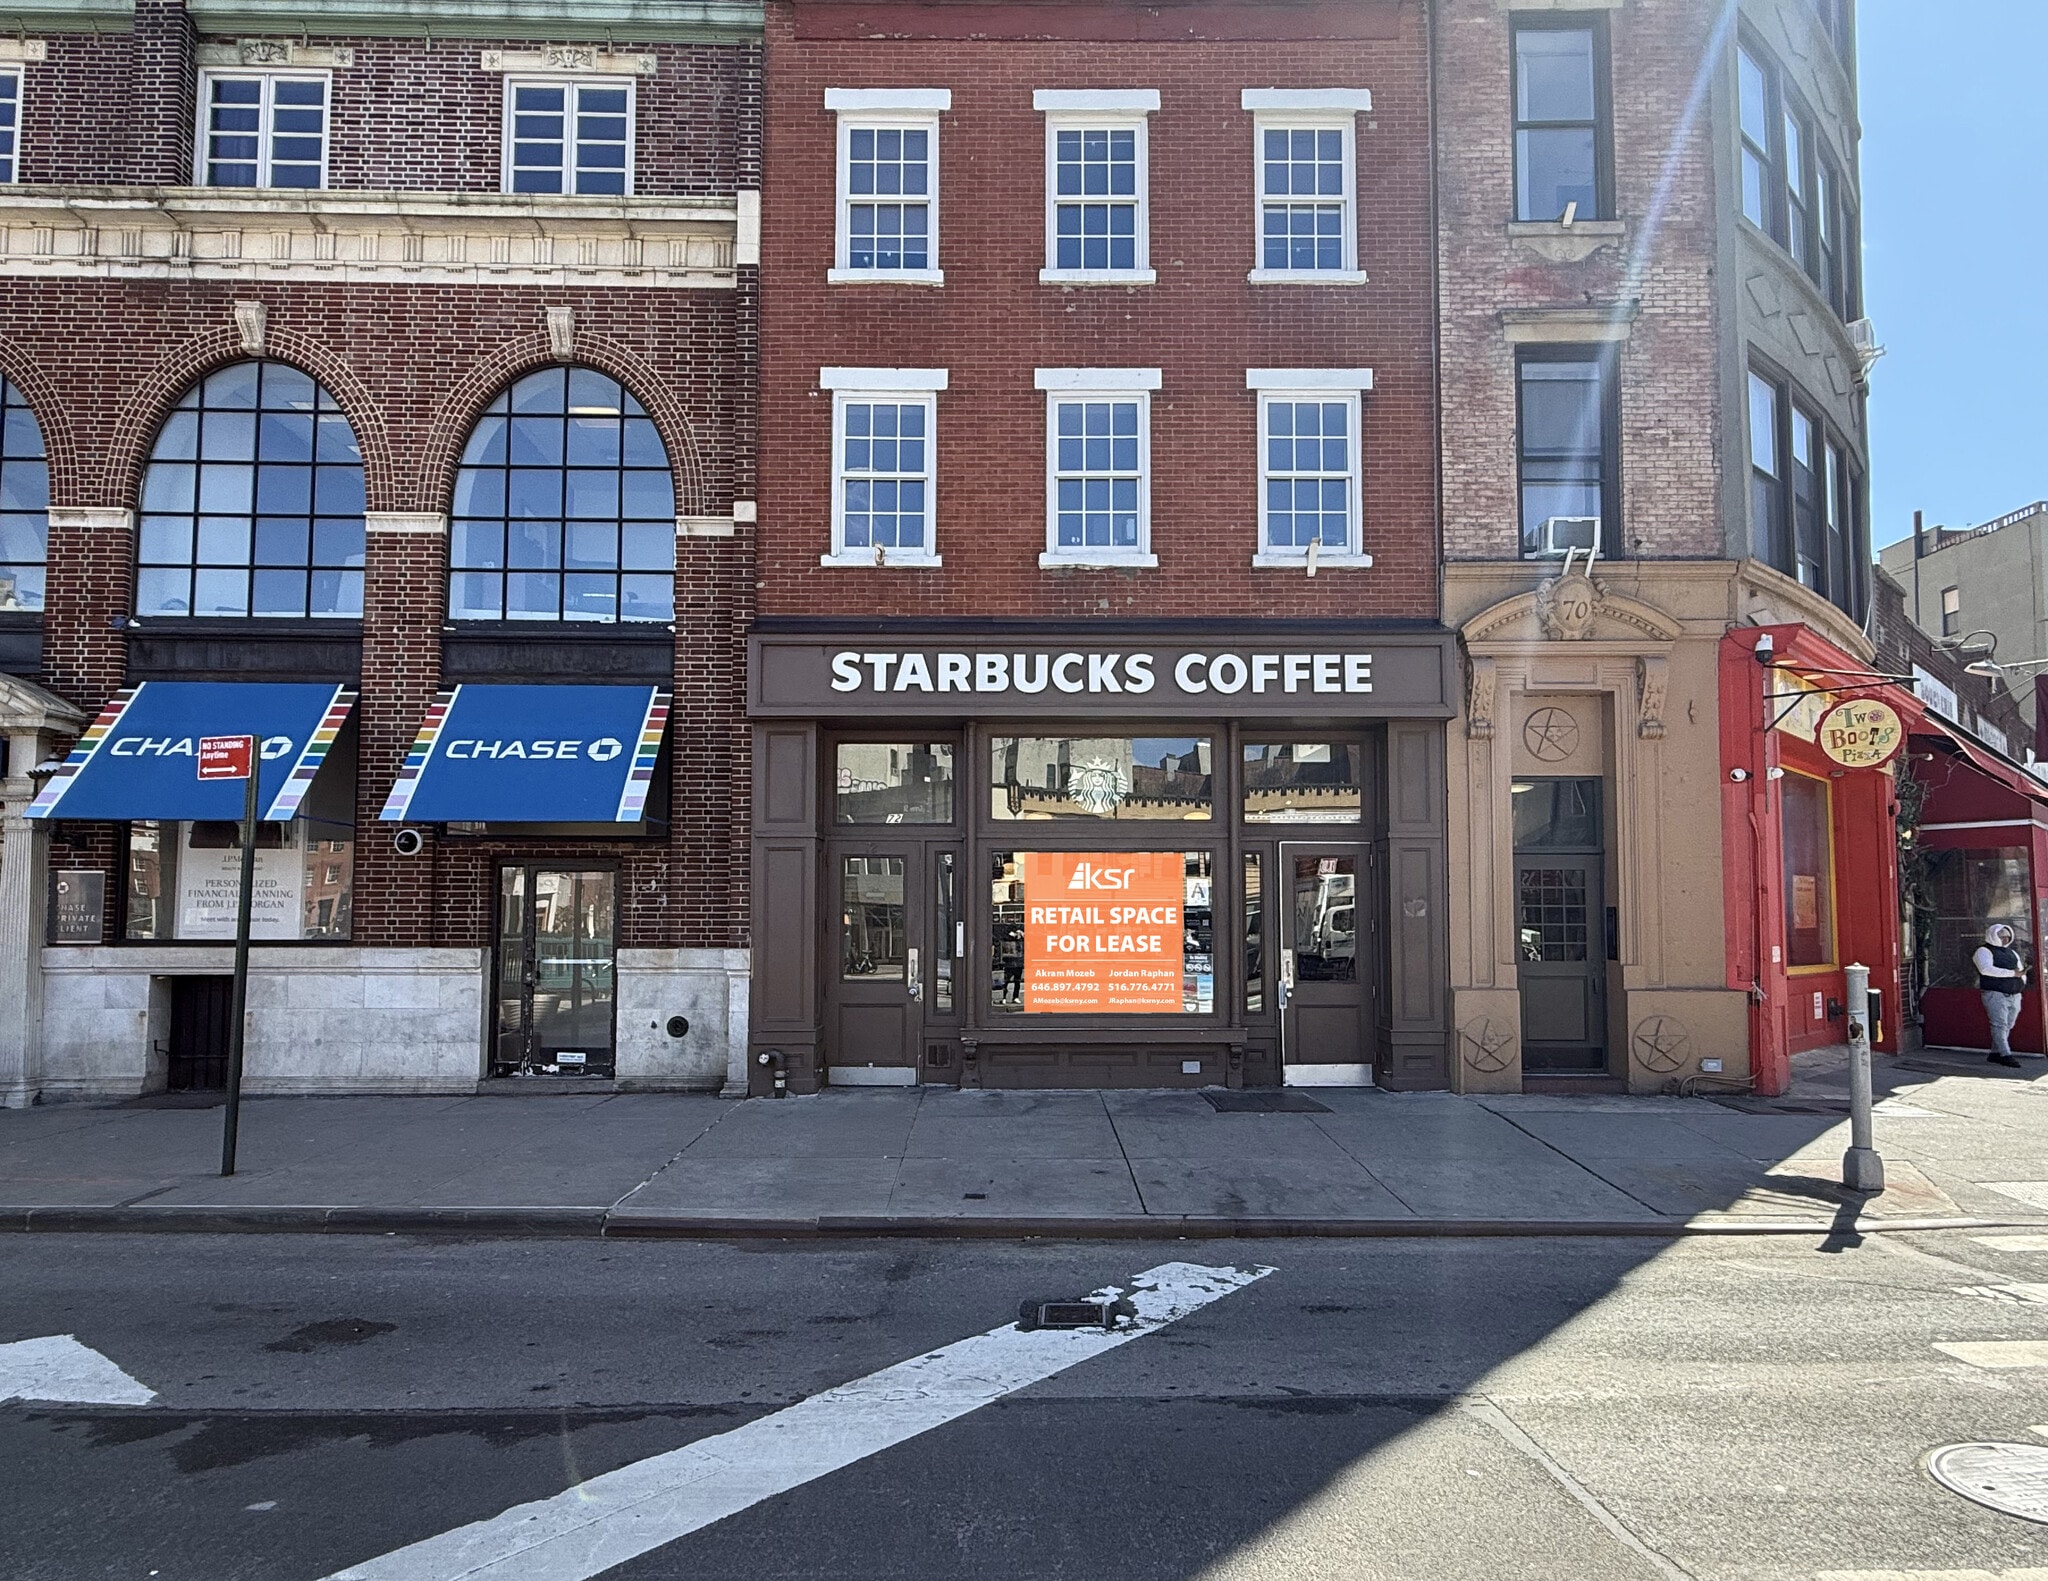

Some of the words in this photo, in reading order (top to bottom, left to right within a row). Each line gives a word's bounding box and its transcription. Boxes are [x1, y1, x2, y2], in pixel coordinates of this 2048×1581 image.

[1563, 600, 1588, 620] 70
[830, 652, 1155, 694] STARBUCKS
[1175, 652, 1373, 694] COFFEE
[110, 737, 200, 757] CHA
[202, 742, 211, 750] NO
[212, 740, 244, 750] STANDING
[445, 740, 583, 759] CHASE
[201, 751, 229, 760] Anytime
[885, 814, 903, 823] 72
[1085, 862, 1136, 889] ksr
[205, 879, 277, 888] PERSONIZED
[187, 889, 239, 898] FINANCIAL
[252, 890, 293, 899] ANNING
[1191, 882, 1205, 899] A
[196, 900, 224, 908] FROM
[251, 900, 284, 908] ORGAN
[1031, 907, 1104, 924] RETAIL
[1110, 907, 1177, 924] SPACE
[57, 925, 88, 933] LIENT
[1046, 935, 1090, 952] FOR
[1095, 935, 1161, 952] LEASE
[1035, 969, 1064, 977] Akram
[1066, 969, 1095, 977] Mozeb
[1108, 969, 1139, 977] Jordan
[1141, 969, 1175, 979] Raphan
[1031, 982, 1100, 991] 646.897.4792
[1108, 982, 1175, 991] 516.776.4771
[1033, 997, 1098, 1005] AMozeb@ksrny.com
[1108, 997, 1176, 1005] JRaphan@ksrny.com
